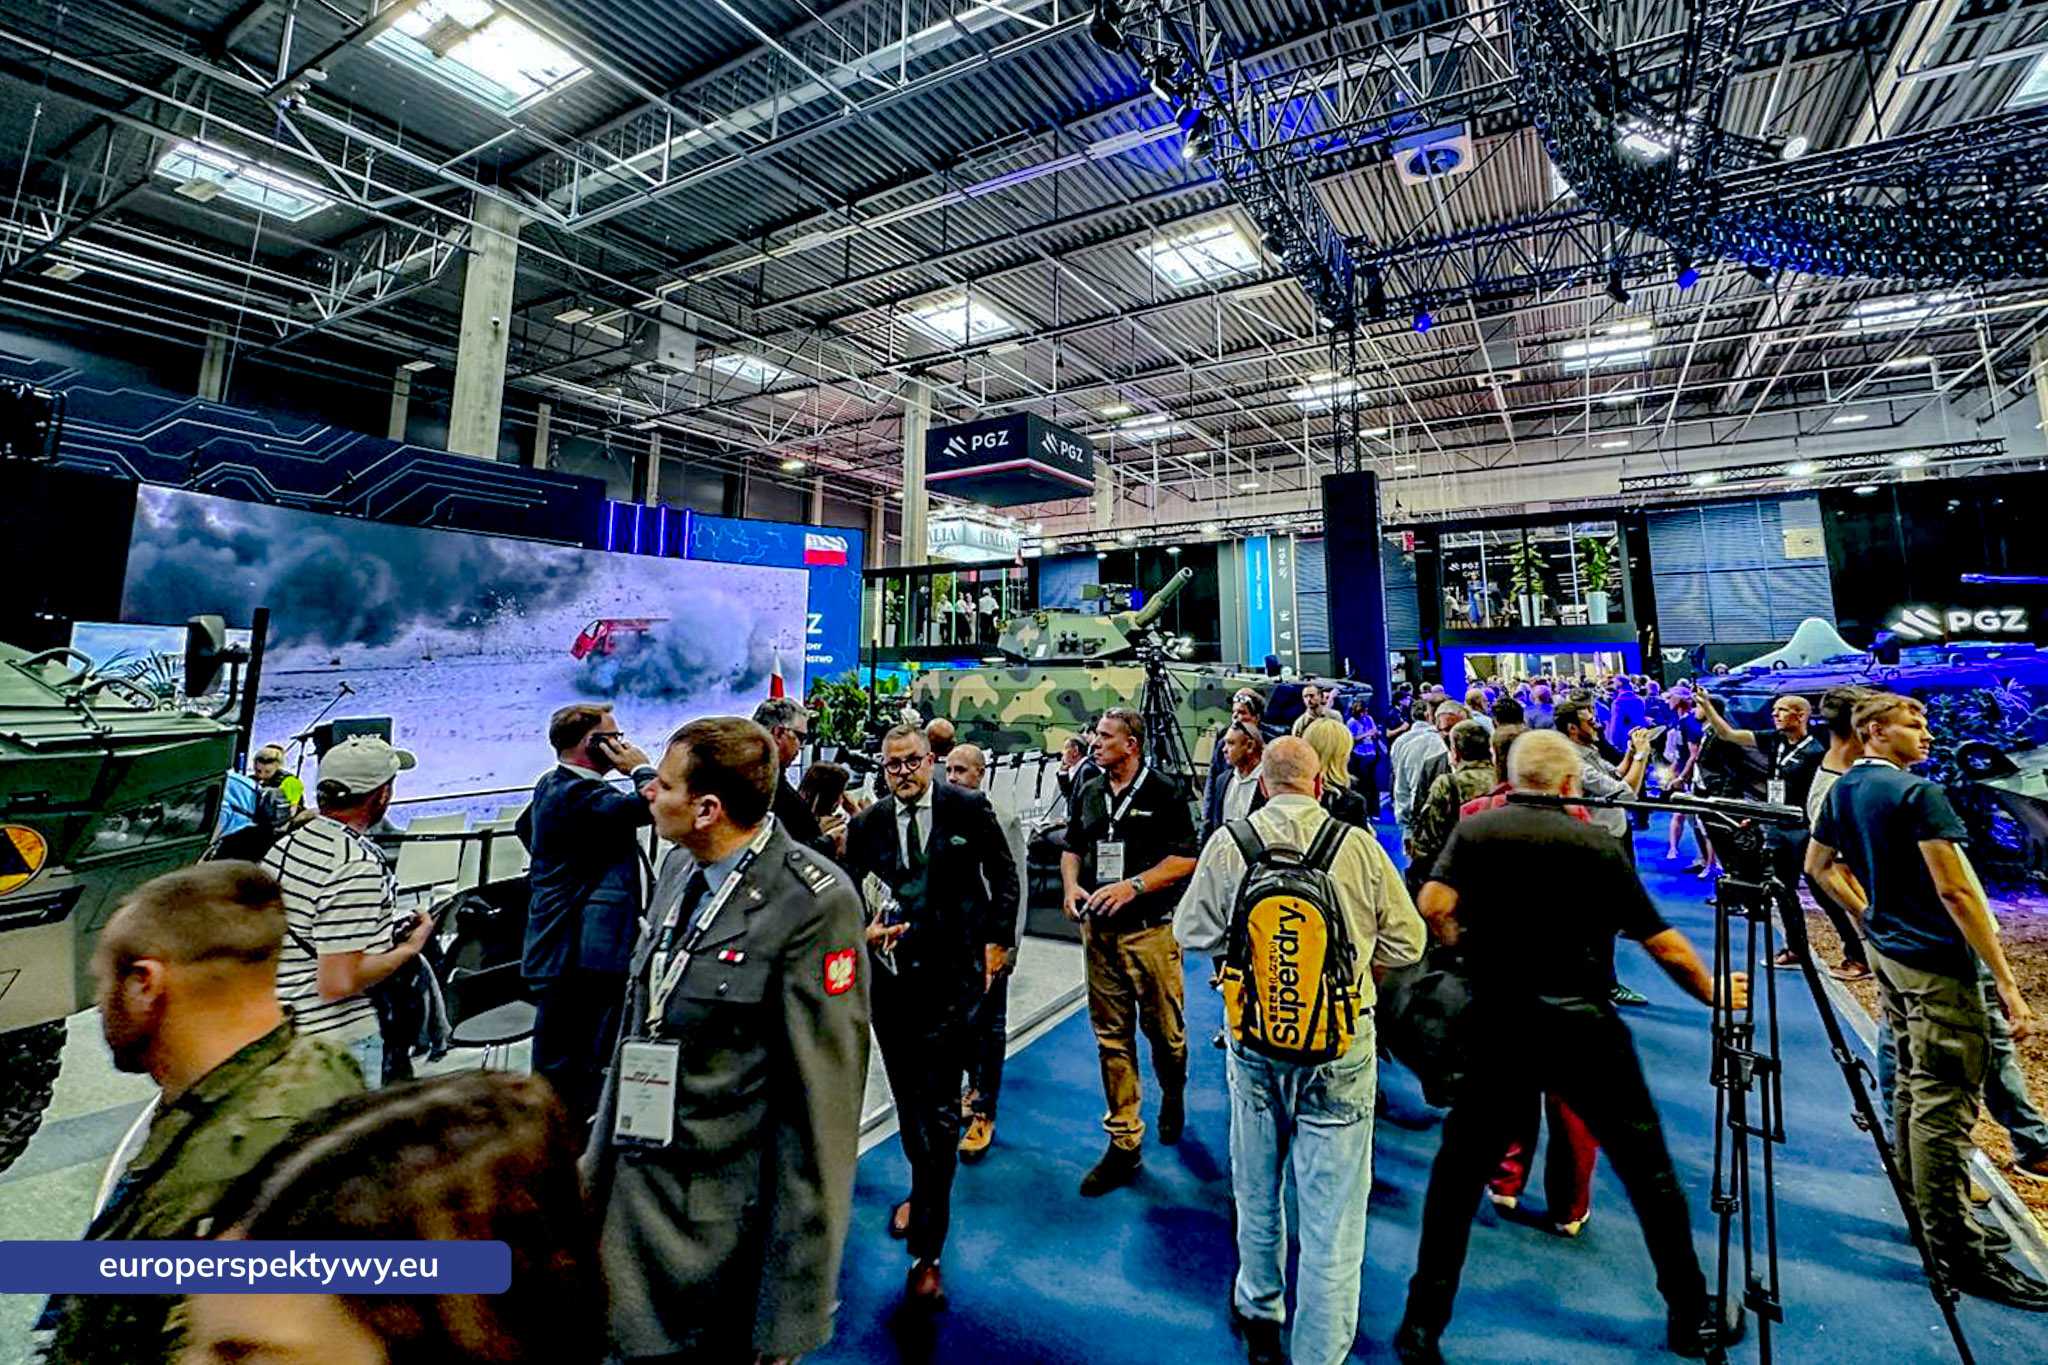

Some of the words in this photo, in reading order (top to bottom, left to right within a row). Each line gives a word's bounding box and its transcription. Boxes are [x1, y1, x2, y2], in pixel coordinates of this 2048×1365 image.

[971, 430, 1009, 451] PGZ
[1060, 441, 1083, 463] PGZ
[1949, 609, 2028, 632] PGZ
